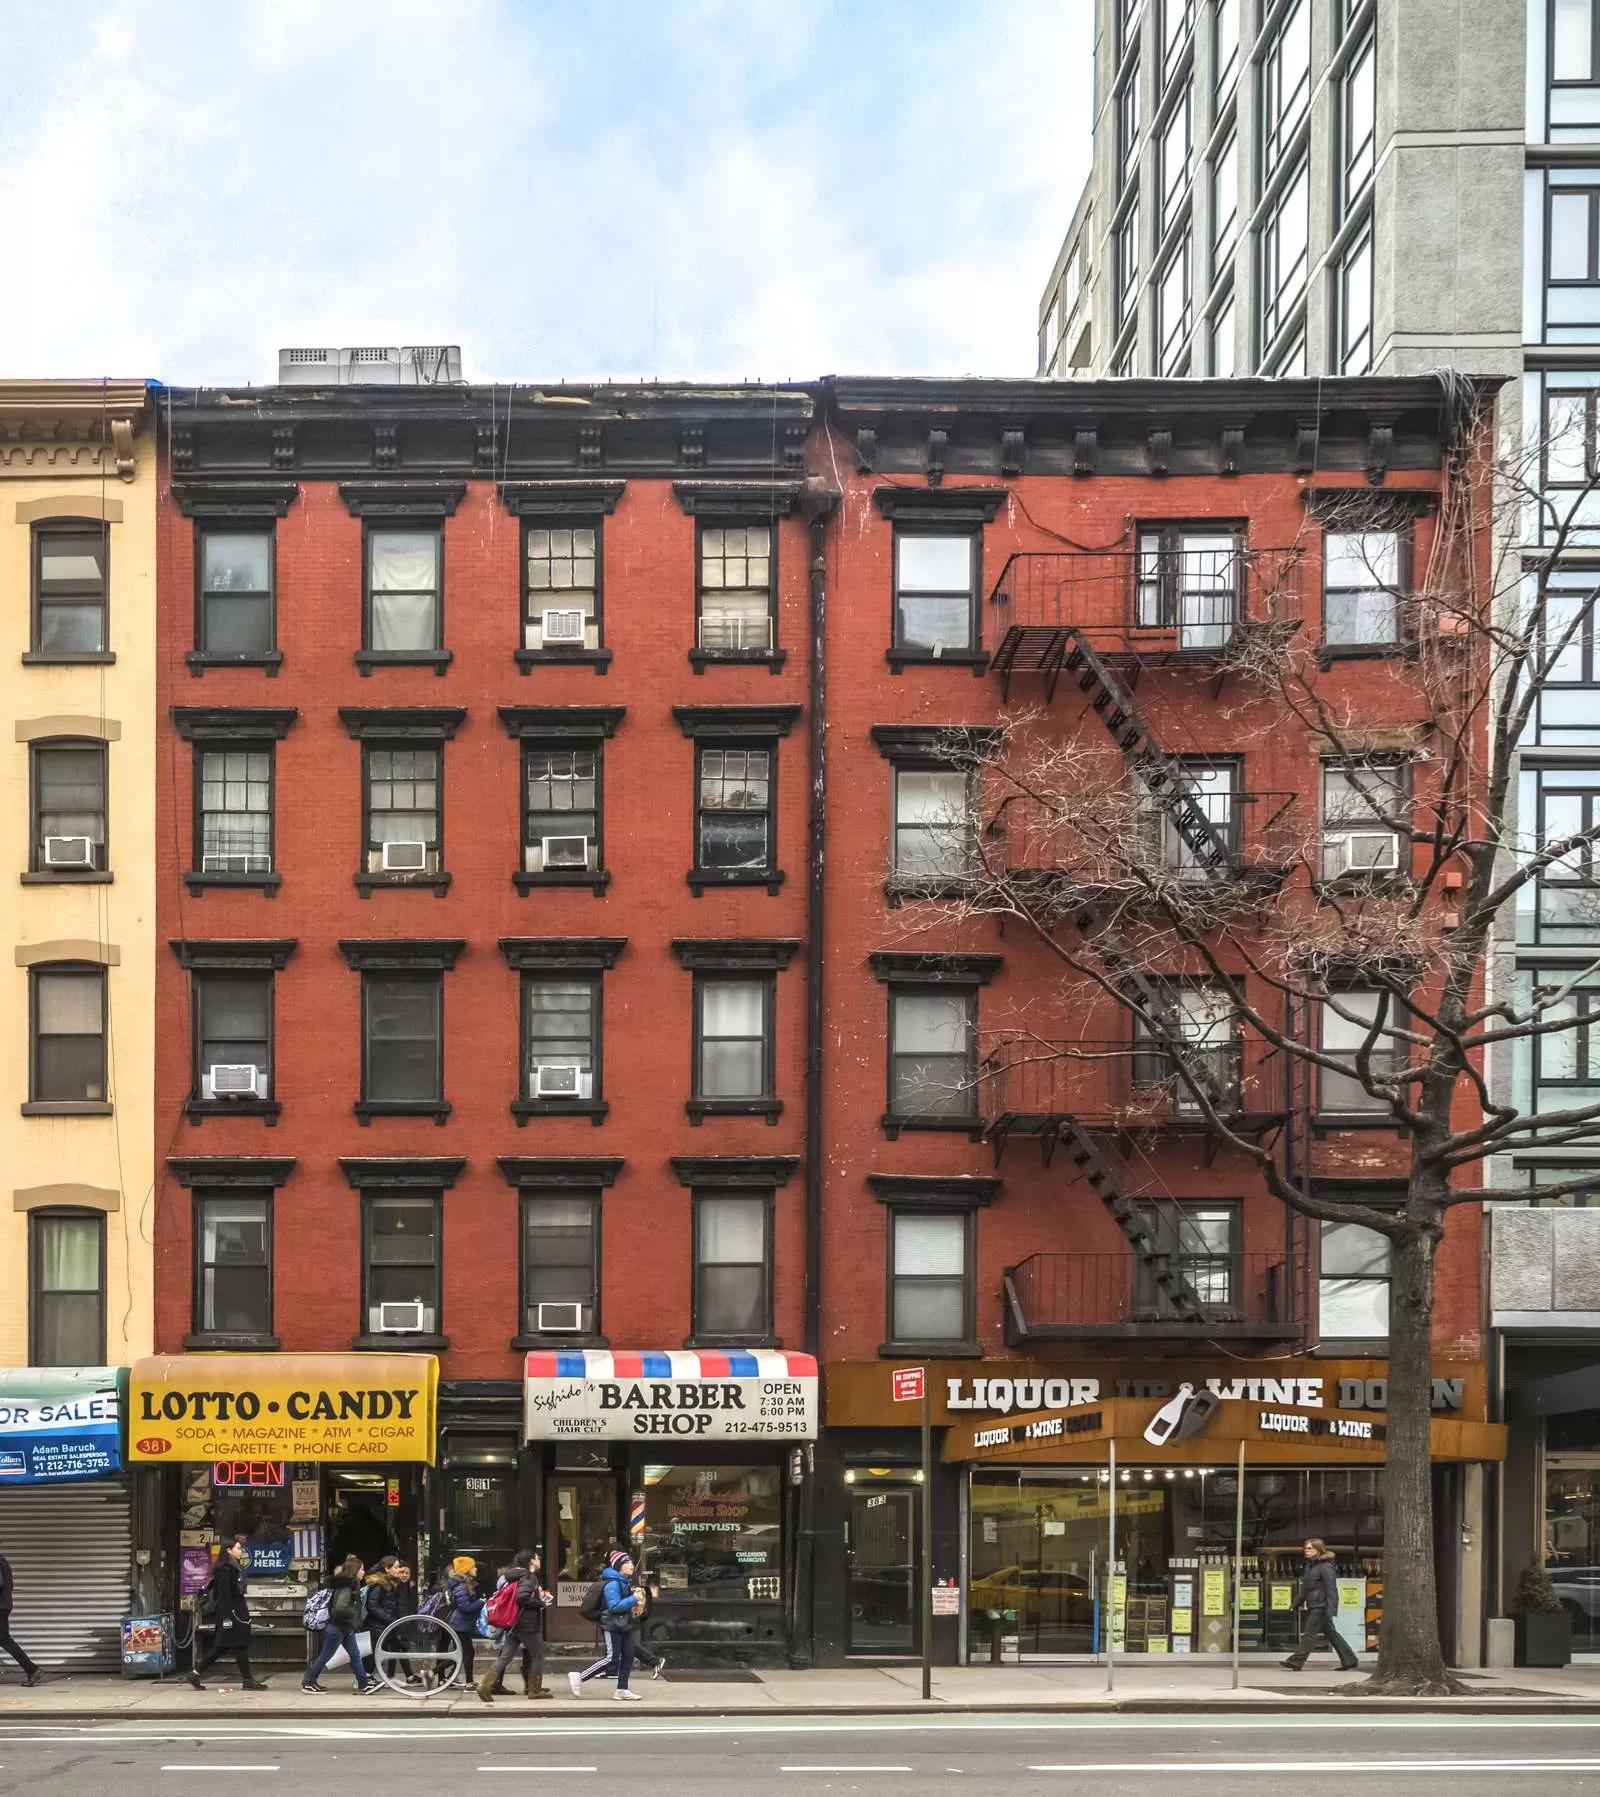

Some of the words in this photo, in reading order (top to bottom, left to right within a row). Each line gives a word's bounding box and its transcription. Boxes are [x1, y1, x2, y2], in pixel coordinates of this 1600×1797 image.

[763, 1383, 802, 1394] OPEN
[599, 1384, 746, 1409] BARBER
[760, 1397, 784, 1406] 7:30
[786, 1397, 805, 1406] AM
[946, 1378, 1100, 1413] LIQUOR
[1206, 1378, 1324, 1408] WINE
[1338, 1378, 1464, 1408] DON
[39, 1400, 104, 1422] SALE
[140, 1391, 260, 1420] LOTTO
[286, 1390, 418, 1420] CANDY
[760, 1407, 784, 1416] 6:00
[787, 1407, 805, 1416] PM
[633, 1414, 712, 1434] SHOP
[725, 1422, 808, 1433] 212-475-9513
[1260, 1412, 1308, 1432] LIQUOR
[1329, 1421, 1336, 1433] &
[1338, 1420, 1371, 1438] WINE
[176, 1427, 216, 1439] SODA
[232, 1427, 307, 1439] MAGAZINE
[323, 1427, 351, 1438] ATM
[368, 1426, 415, 1438] CIGAR
[974, 1427, 1009, 1447] LIQUOR
[1025, 1425, 1032, 1437] &
[1032, 1418, 1062, 1438] WINE
[32, 1446, 59, 1454] Adam
[61, 1442, 95, 1453] Baruch
[142, 1440, 166, 1452] 381
[202, 1443, 276, 1454] CIGARETTE
[294, 1443, 342, 1454] PHONE
[347, 1442, 388, 1454] CARD
[34, 1463, 43, 1471] +1
[47, 1458, 110, 1471] 212-716-3752
[214, 1461, 283, 1485] OPEN
[700, 1471, 717, 1480] 381
[673, 1523, 741, 1532] HAIRSTYLISTS
[254, 1550, 281, 1559] PLAY
[254, 1560, 286, 1568] HERE.
